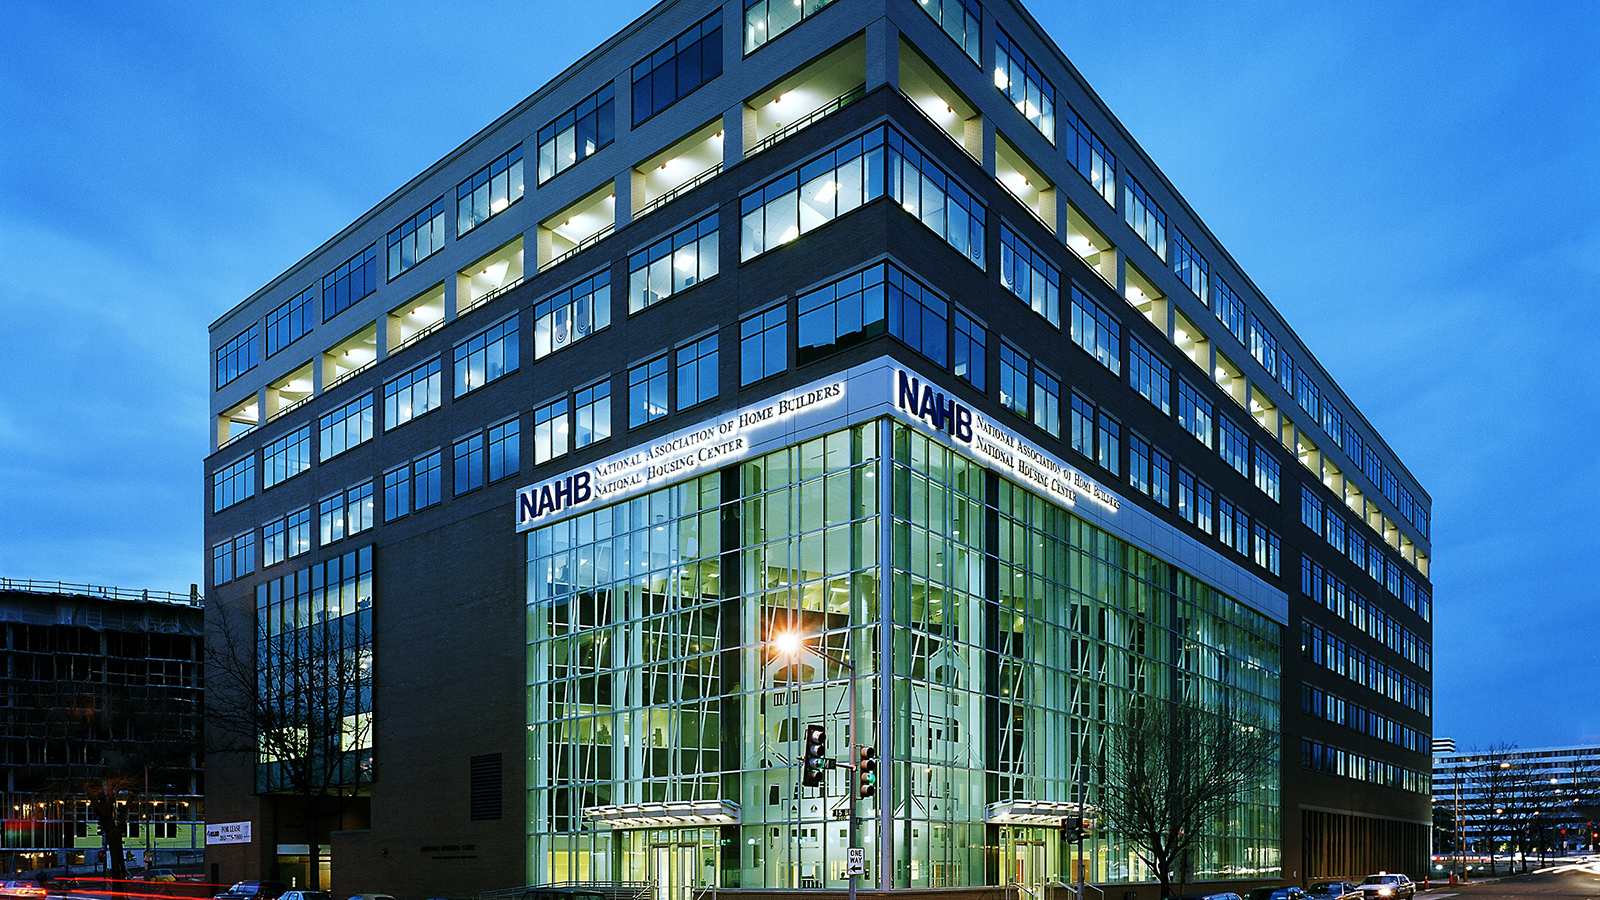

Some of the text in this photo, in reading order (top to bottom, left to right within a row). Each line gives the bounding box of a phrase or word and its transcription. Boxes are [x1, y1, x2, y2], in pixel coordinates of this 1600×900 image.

[595, 383, 841, 479] NATIONAL ASSOCIATION OF HOME BUILDERS
[899, 370, 972, 443] NAHB
[520, 471, 592, 522] NAHB
[595, 438, 744, 498] NATIONAL HOUSING CENTER
[976, 435, 1077, 503] NATIONAL HOUSING CENTER
[977, 415, 1014, 448] NATIONAL
[1017, 441, 1062, 475] ASSOCIATION
[1074, 473, 1092, 494] HOME
[1094, 485, 1121, 510] BUILDERS
